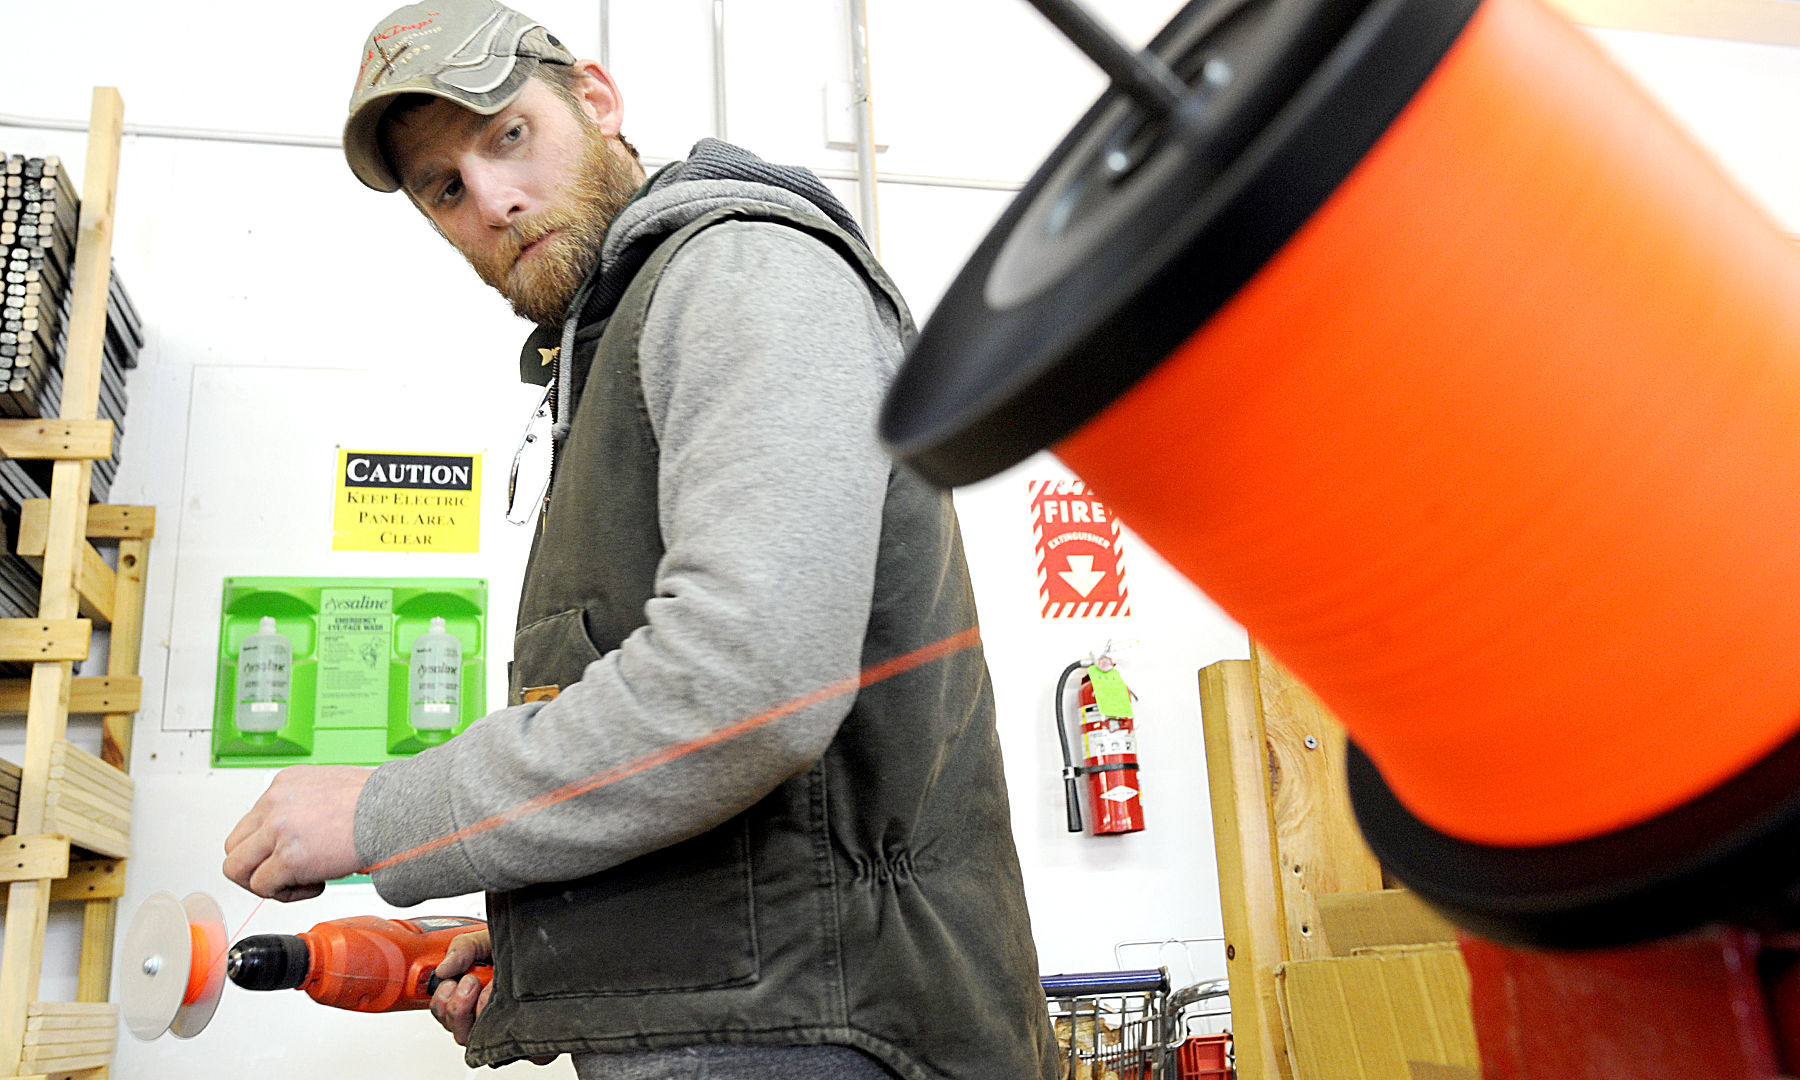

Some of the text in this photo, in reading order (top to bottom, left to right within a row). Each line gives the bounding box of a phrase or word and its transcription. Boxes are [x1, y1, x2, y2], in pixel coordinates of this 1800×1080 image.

[346, 458, 470, 486] CAUTION
[347, 491, 470, 507] KEEP ELECTRIC
[359, 511, 456, 526] PANEL AREA
[1043, 500, 1107, 524] FIRE
[380, 531, 432, 545] CLEAR
[1047, 531, 1111, 550] EXTINGUISHER
